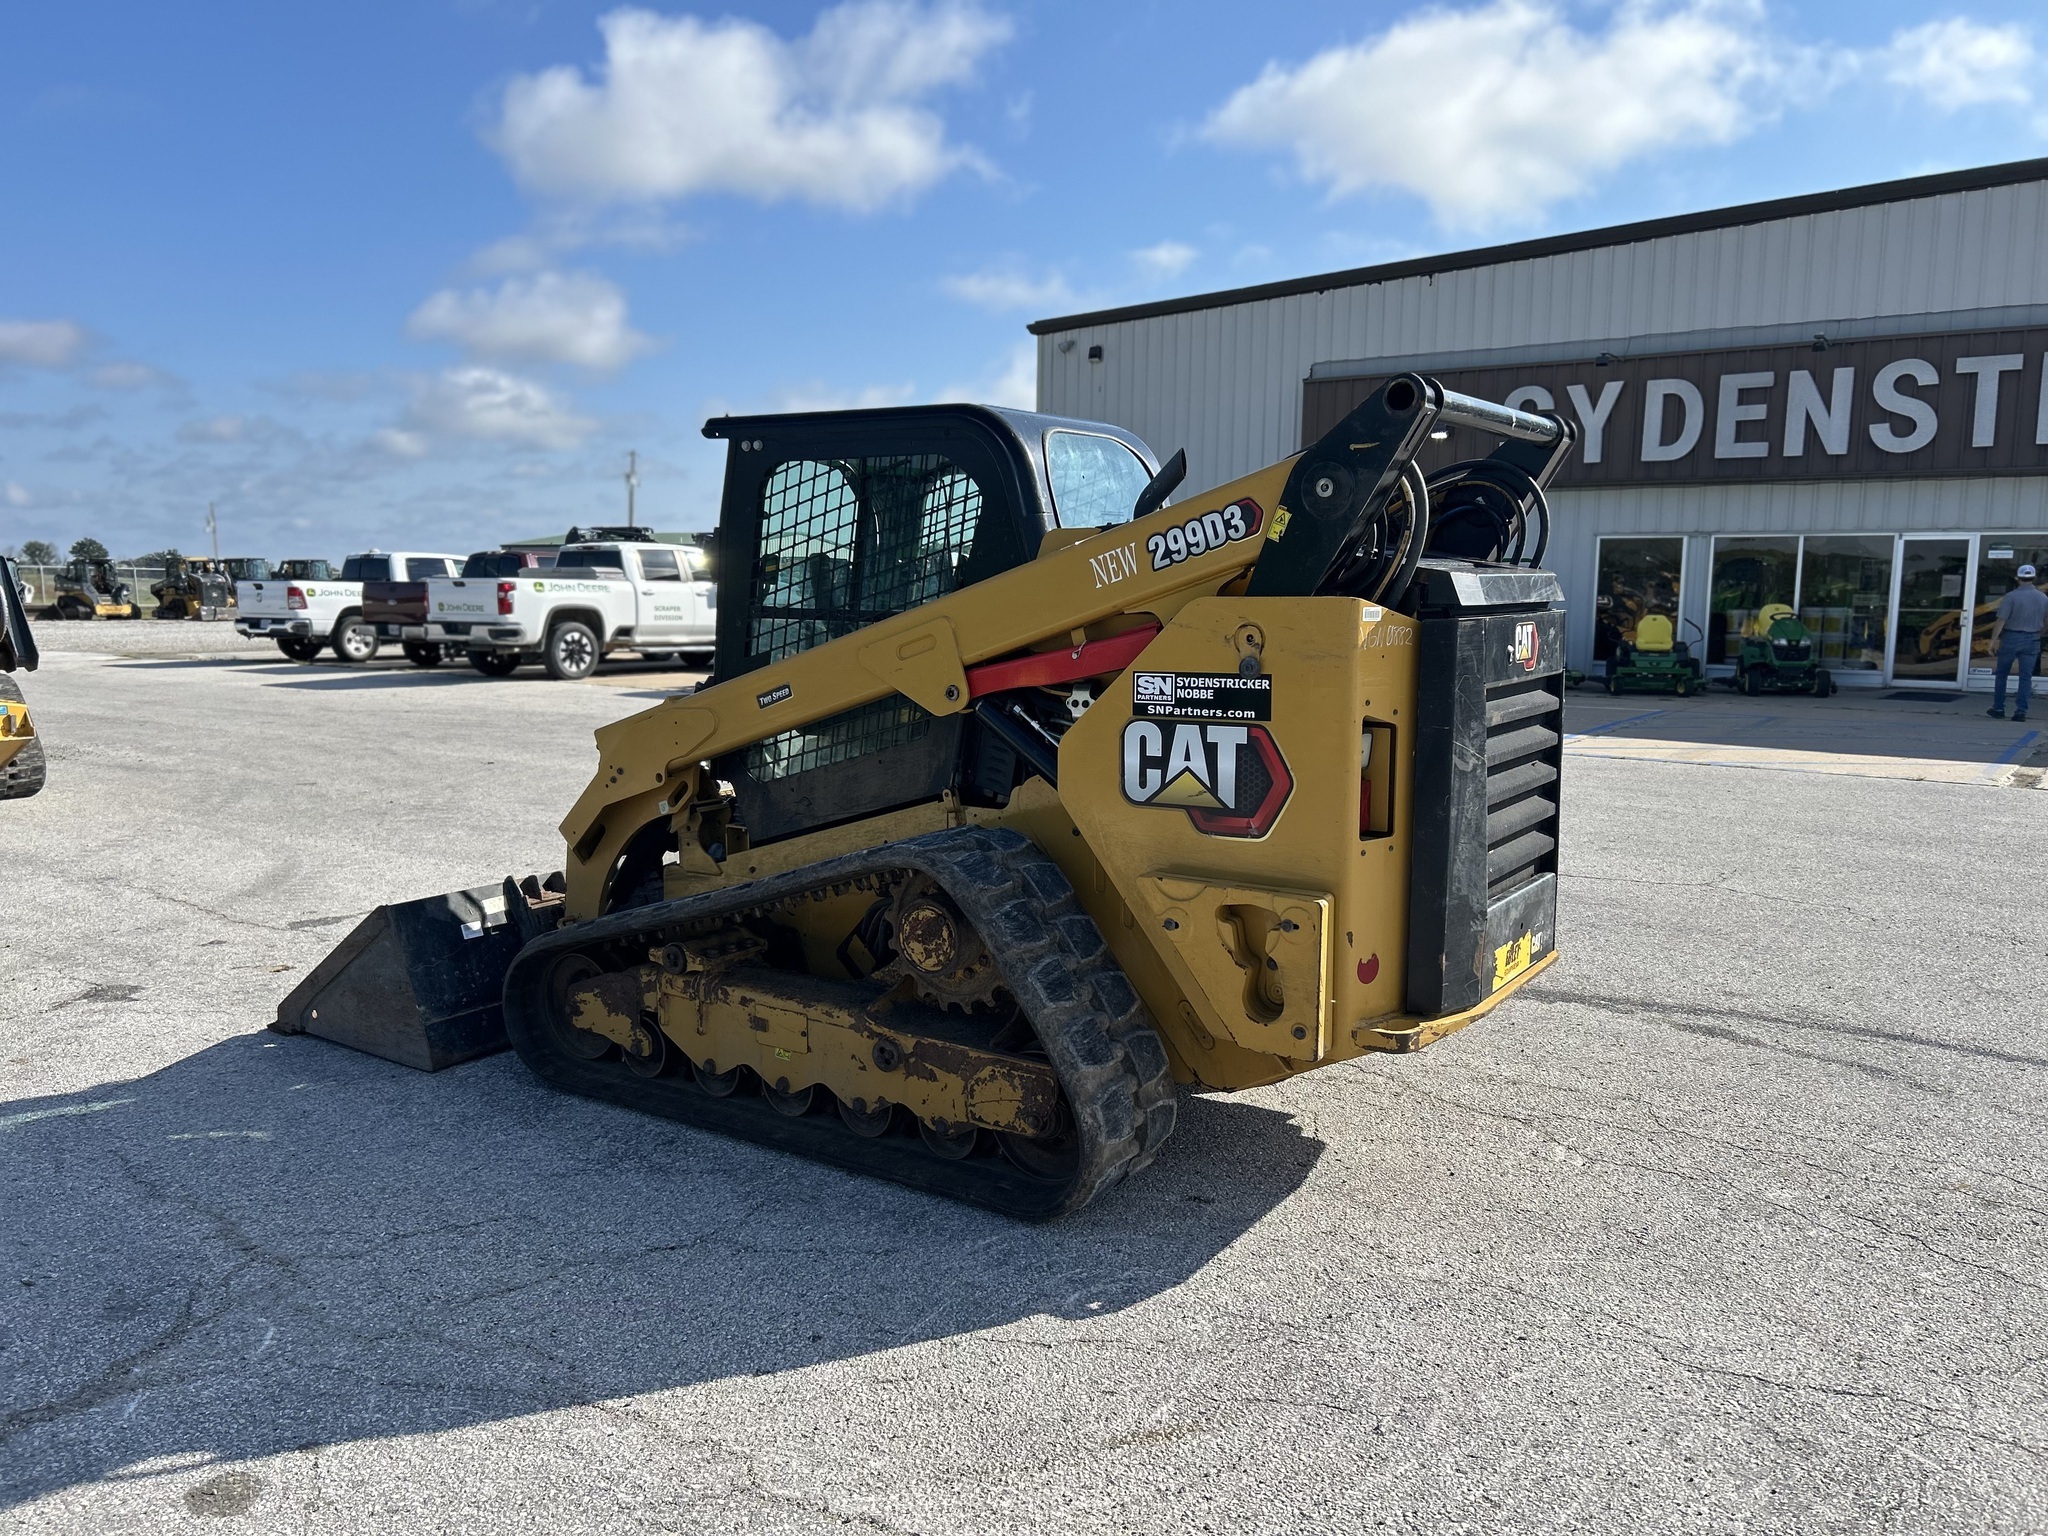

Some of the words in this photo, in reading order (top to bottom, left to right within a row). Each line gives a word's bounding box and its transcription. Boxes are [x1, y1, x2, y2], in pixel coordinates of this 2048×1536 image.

[1499, 351, 2048, 464] YDENST
[1089, 542, 1138, 589] NEW
[1148, 504, 1247, 570] 299D3
[318, 588, 343, 597] JOHN
[547, 582, 576, 593] JOHN
[577, 582, 612, 593] DEERE
[446, 602, 462, 611] JOHN
[463, 603, 485, 612] DEERE
[1515, 625, 1533, 660] CAT
[1137, 676, 1172, 695] SN
[1176, 677, 1271, 690] SYDENSTRICKER
[1176, 688, 1214, 699] NOBBE
[1147, 705, 1256, 718] SNPartners.com
[1124, 721, 1248, 809] CAT
